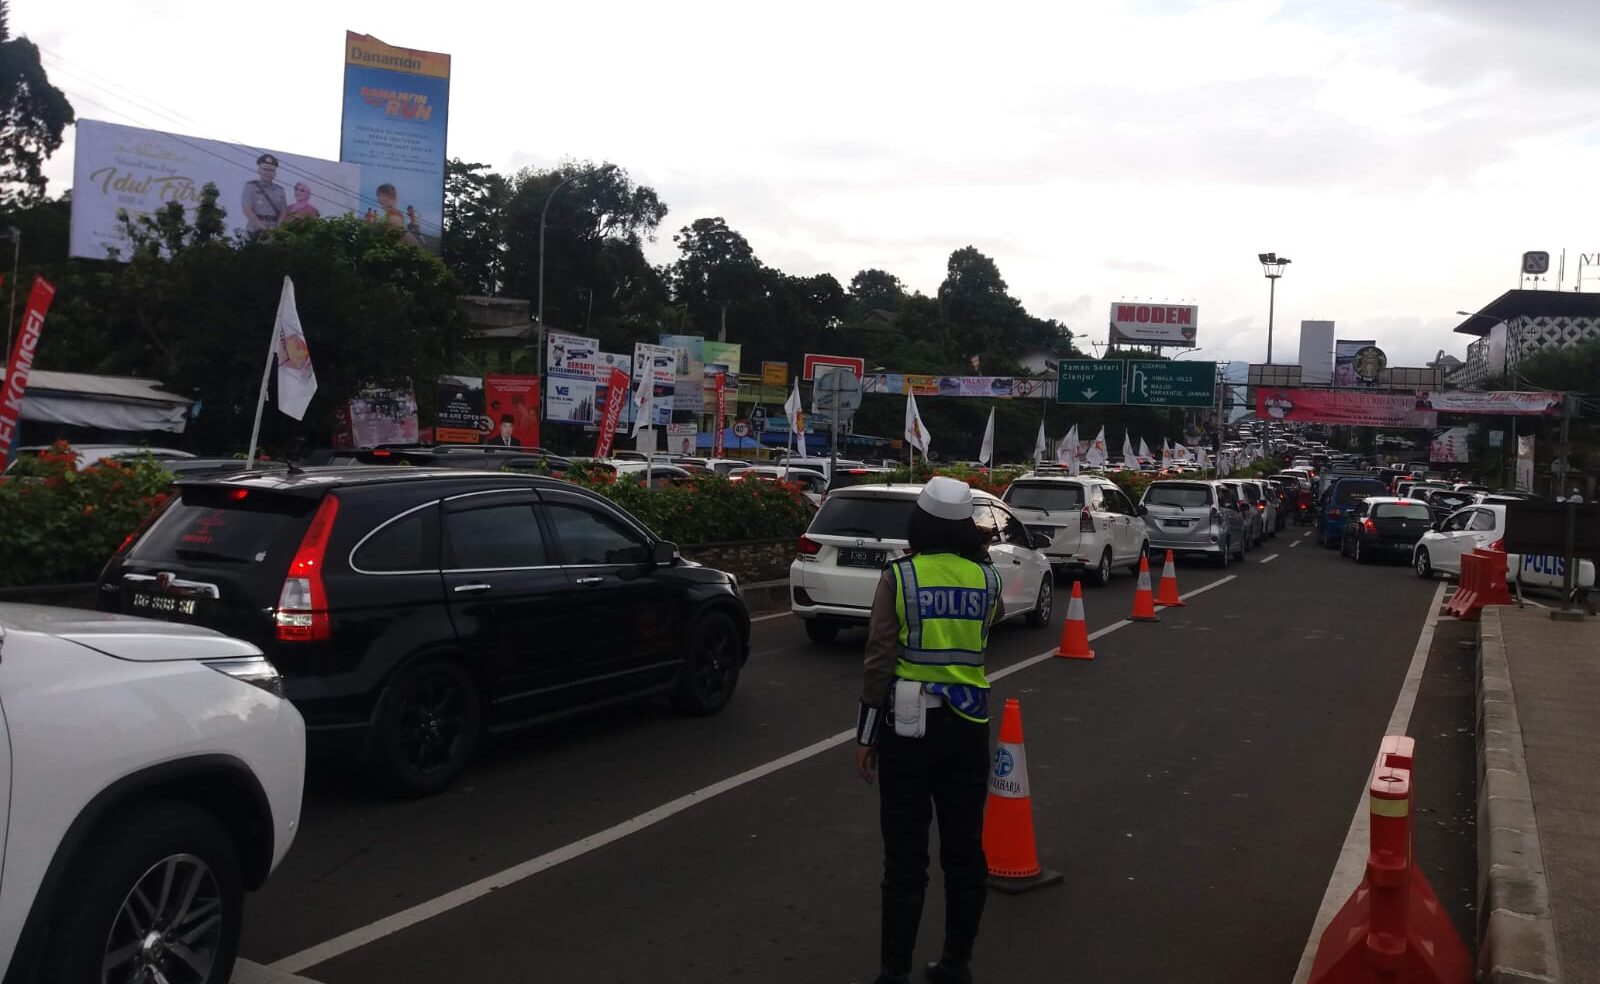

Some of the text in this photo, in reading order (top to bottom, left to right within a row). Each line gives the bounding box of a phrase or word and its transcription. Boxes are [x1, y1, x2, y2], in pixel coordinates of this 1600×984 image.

[352, 47, 421, 69] Danamon
[385, 100, 432, 120] RUN
[90, 167, 152, 194] Idul
[1117, 305, 1192, 325] MODEN
[1063, 363, 1092, 371] Taman
[1063, 373, 1095, 381] Cianjur
[1524, 554, 1567, 576] POLIS
[919, 590, 986, 617] POLISI
